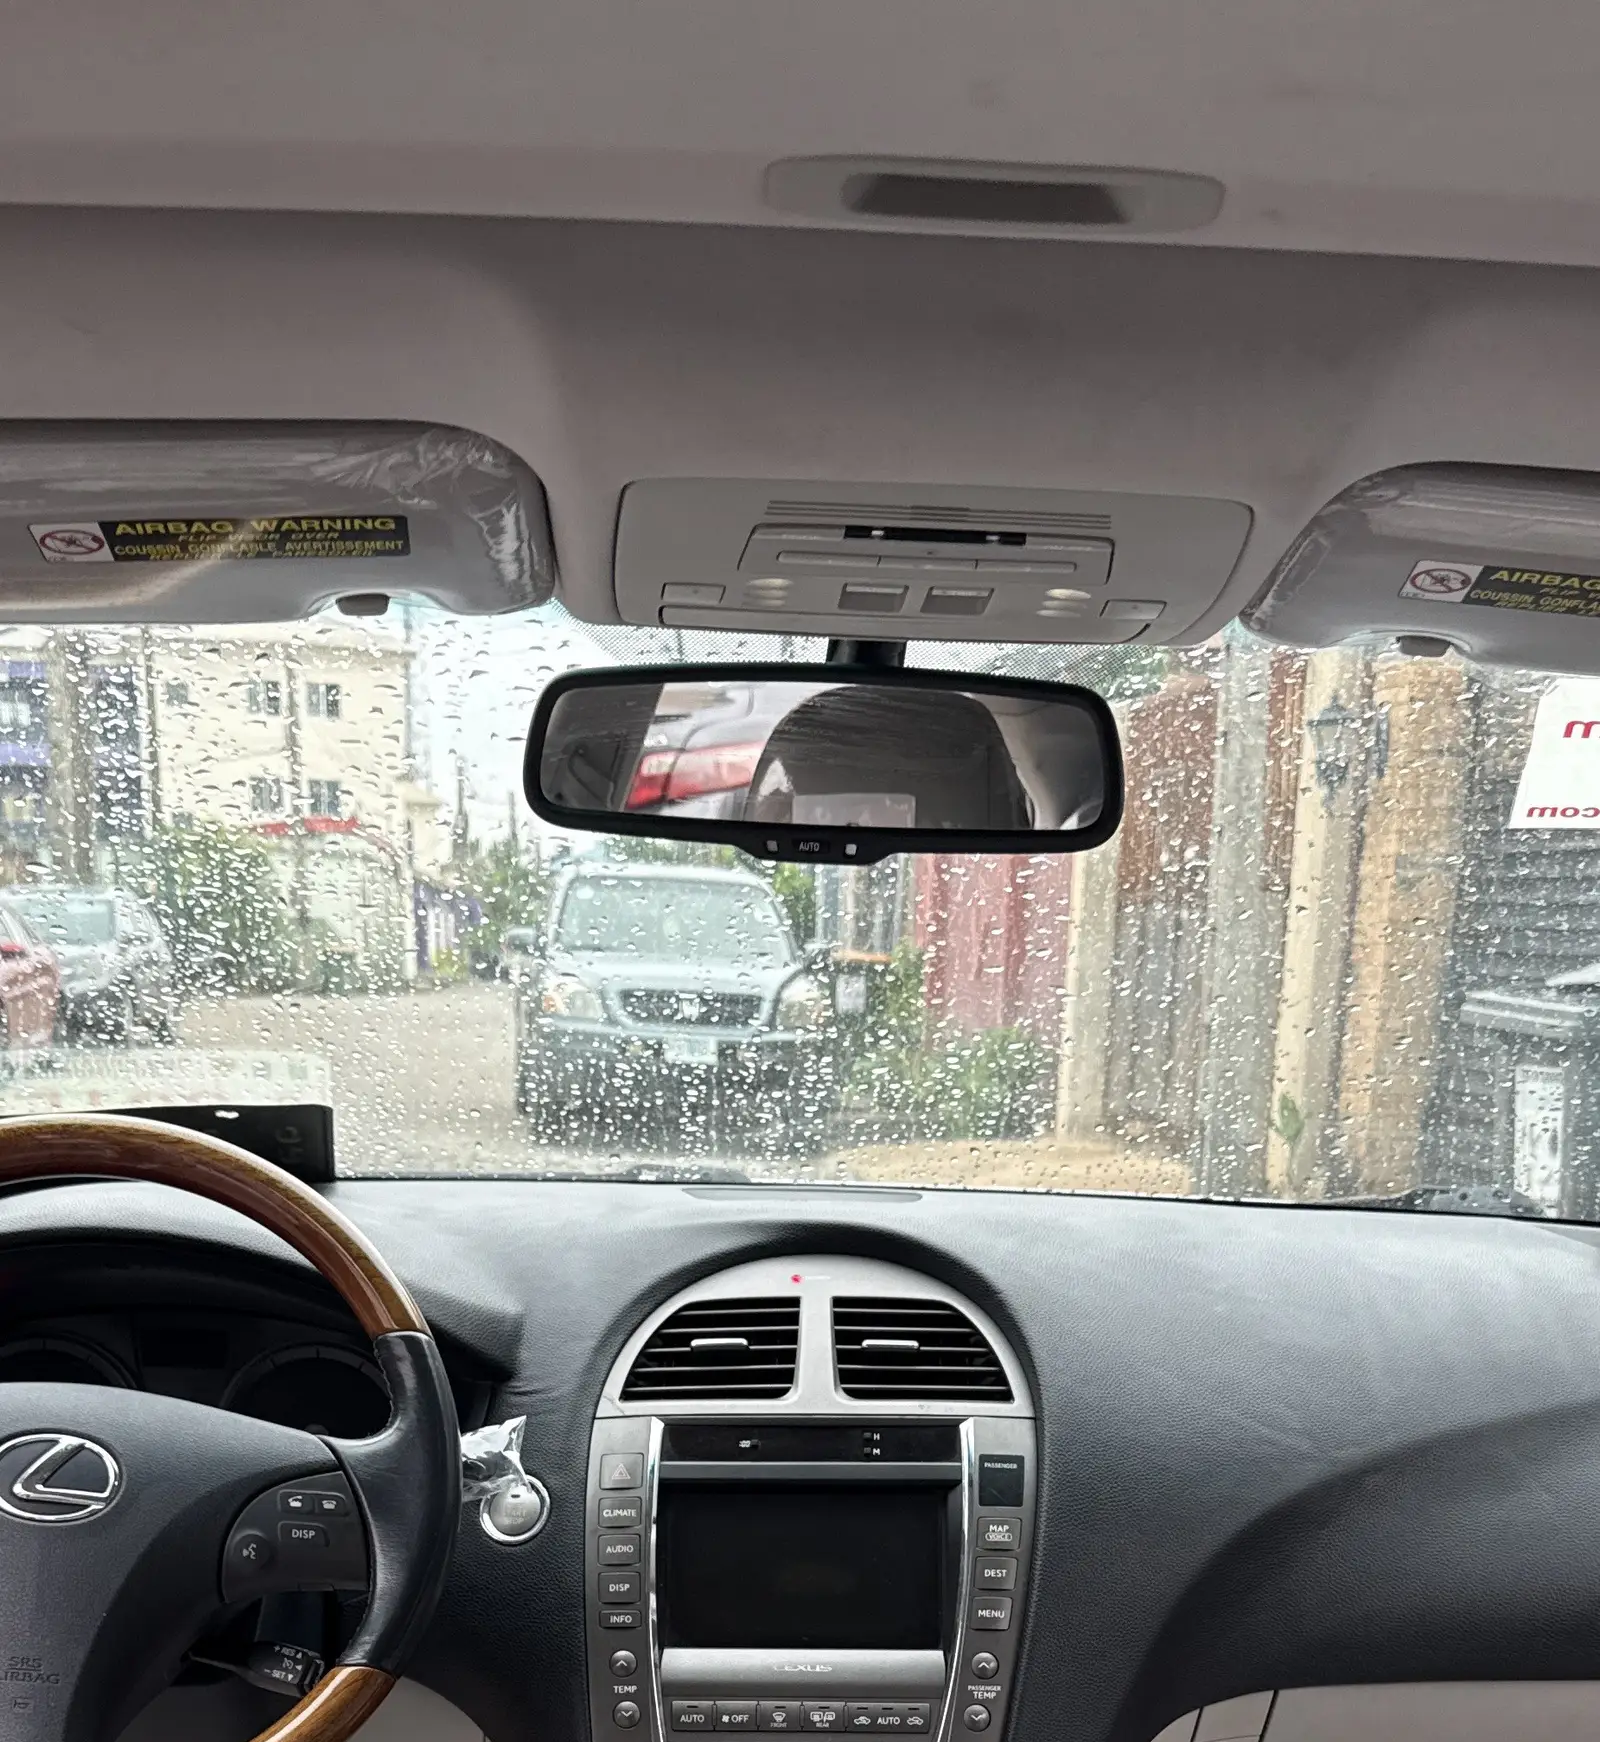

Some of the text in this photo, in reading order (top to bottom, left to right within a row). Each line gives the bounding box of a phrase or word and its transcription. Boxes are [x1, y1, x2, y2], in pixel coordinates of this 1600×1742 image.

[115, 517, 396, 536] AIRBAG WARNING
[114, 543, 181, 556] COUSSIN
[285, 539, 404, 552] AVERTISSEMENT
[1470, 589, 1536, 604] COUSSIN
[799, 841, 820, 851] AUTO
[873, 1432, 881, 1441] H
[872, 1447, 881, 1455] M
[984, 1461, 1018, 1469] PASSENGER
[603, 1508, 637, 1518] CLIMATE
[989, 1524, 1010, 1533] MAP
[291, 1528, 316, 1539] DISP
[988, 1533, 1010, 1541] VOICE
[606, 1544, 634, 1554] AUDIO
[984, 1568, 1008, 1578] DEST
[608, 1583, 631, 1592] DISP
[977, 1609, 1006, 1618] MENU
[610, 1615, 633, 1624] INFO
[0, 1671, 60, 1685] IRBAG
[612, 1685, 638, 1694] TEMP
[972, 1691, 997, 1700] TEMP
[680, 1714, 749, 1723] AUTO OFF
[877, 1716, 900, 1725] AUTO
